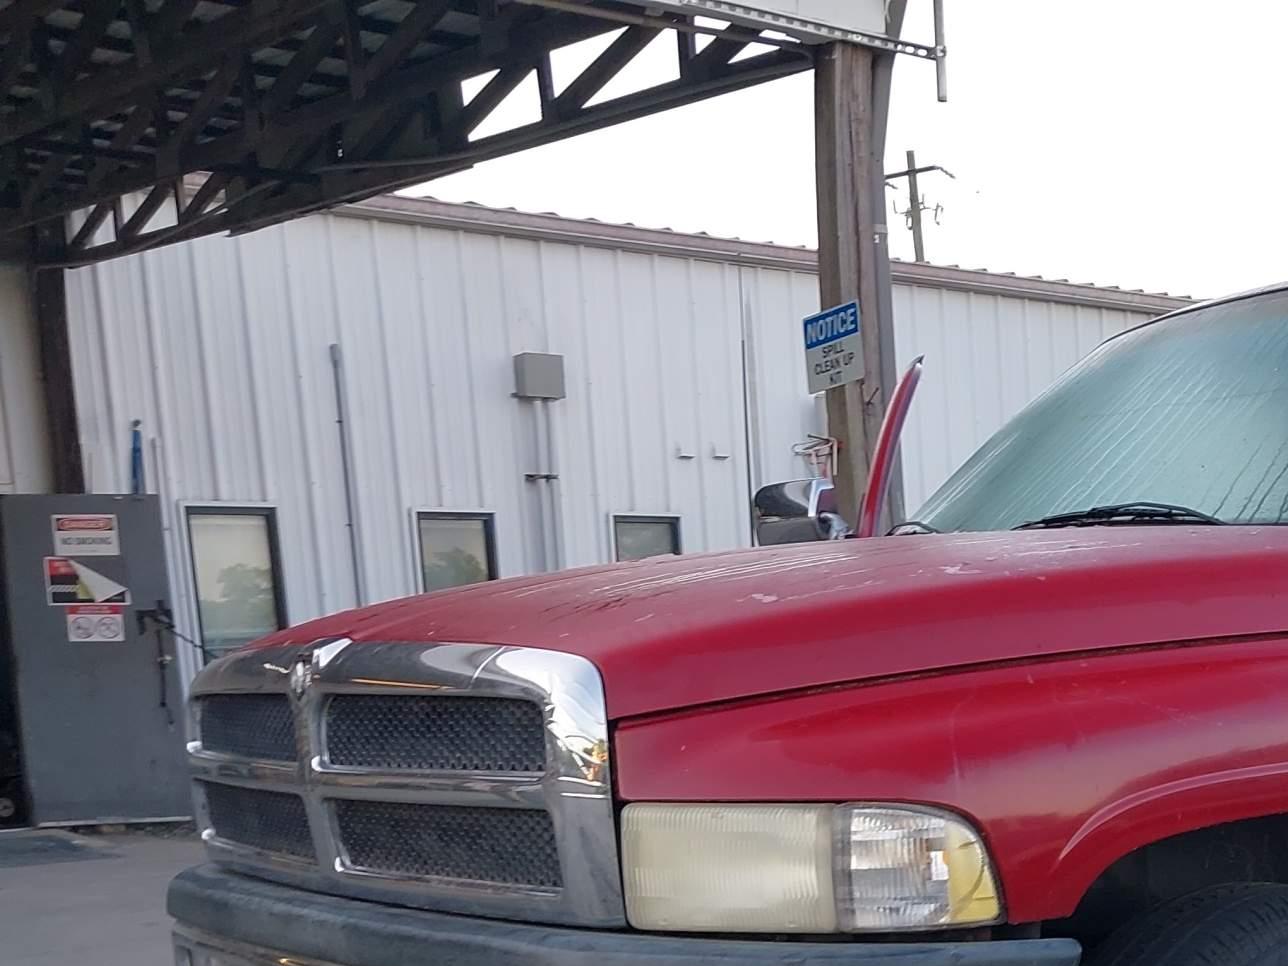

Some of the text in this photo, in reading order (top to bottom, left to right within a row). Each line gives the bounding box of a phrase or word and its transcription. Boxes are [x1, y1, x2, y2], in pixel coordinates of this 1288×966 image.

[807, 308, 858, 345] NOTICE
[823, 341, 844, 358] SPILL
[815, 352, 855, 375] CLEAN UP
